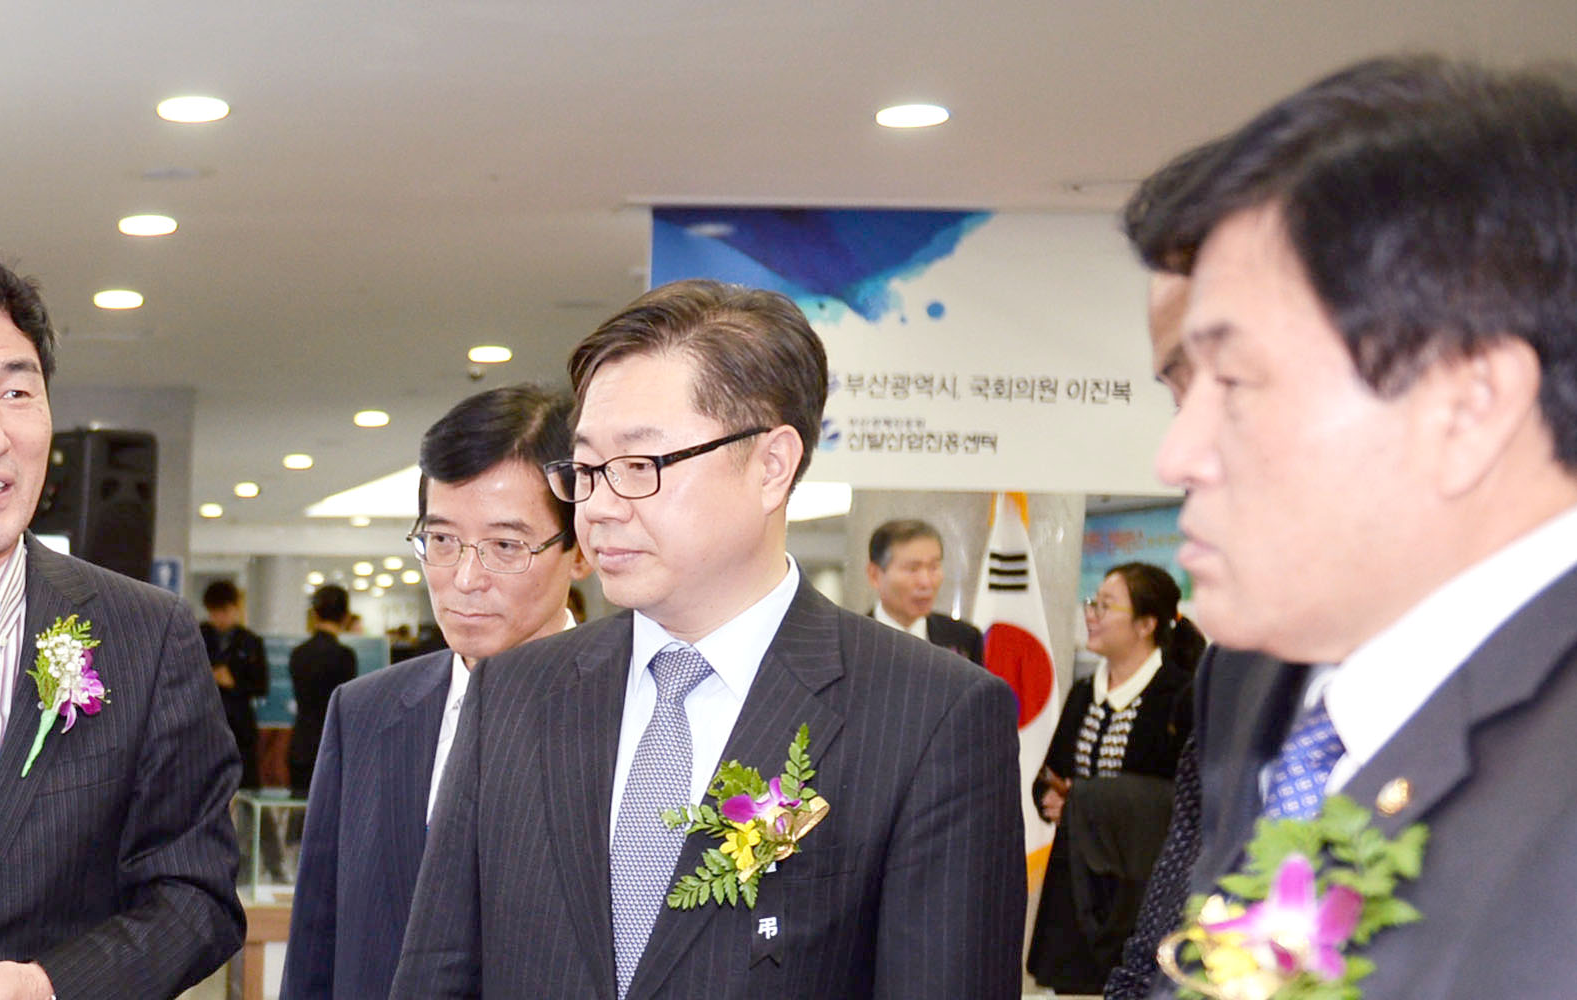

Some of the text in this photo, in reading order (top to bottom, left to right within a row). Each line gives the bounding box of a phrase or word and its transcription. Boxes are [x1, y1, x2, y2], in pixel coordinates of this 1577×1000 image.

[970, 375, 1058, 403] 국회의원
[1067, 378, 1132, 405] 이진복
[848, 431, 998, 454] 신발산업진흥센터
[758, 917, 778, 939] 弔
